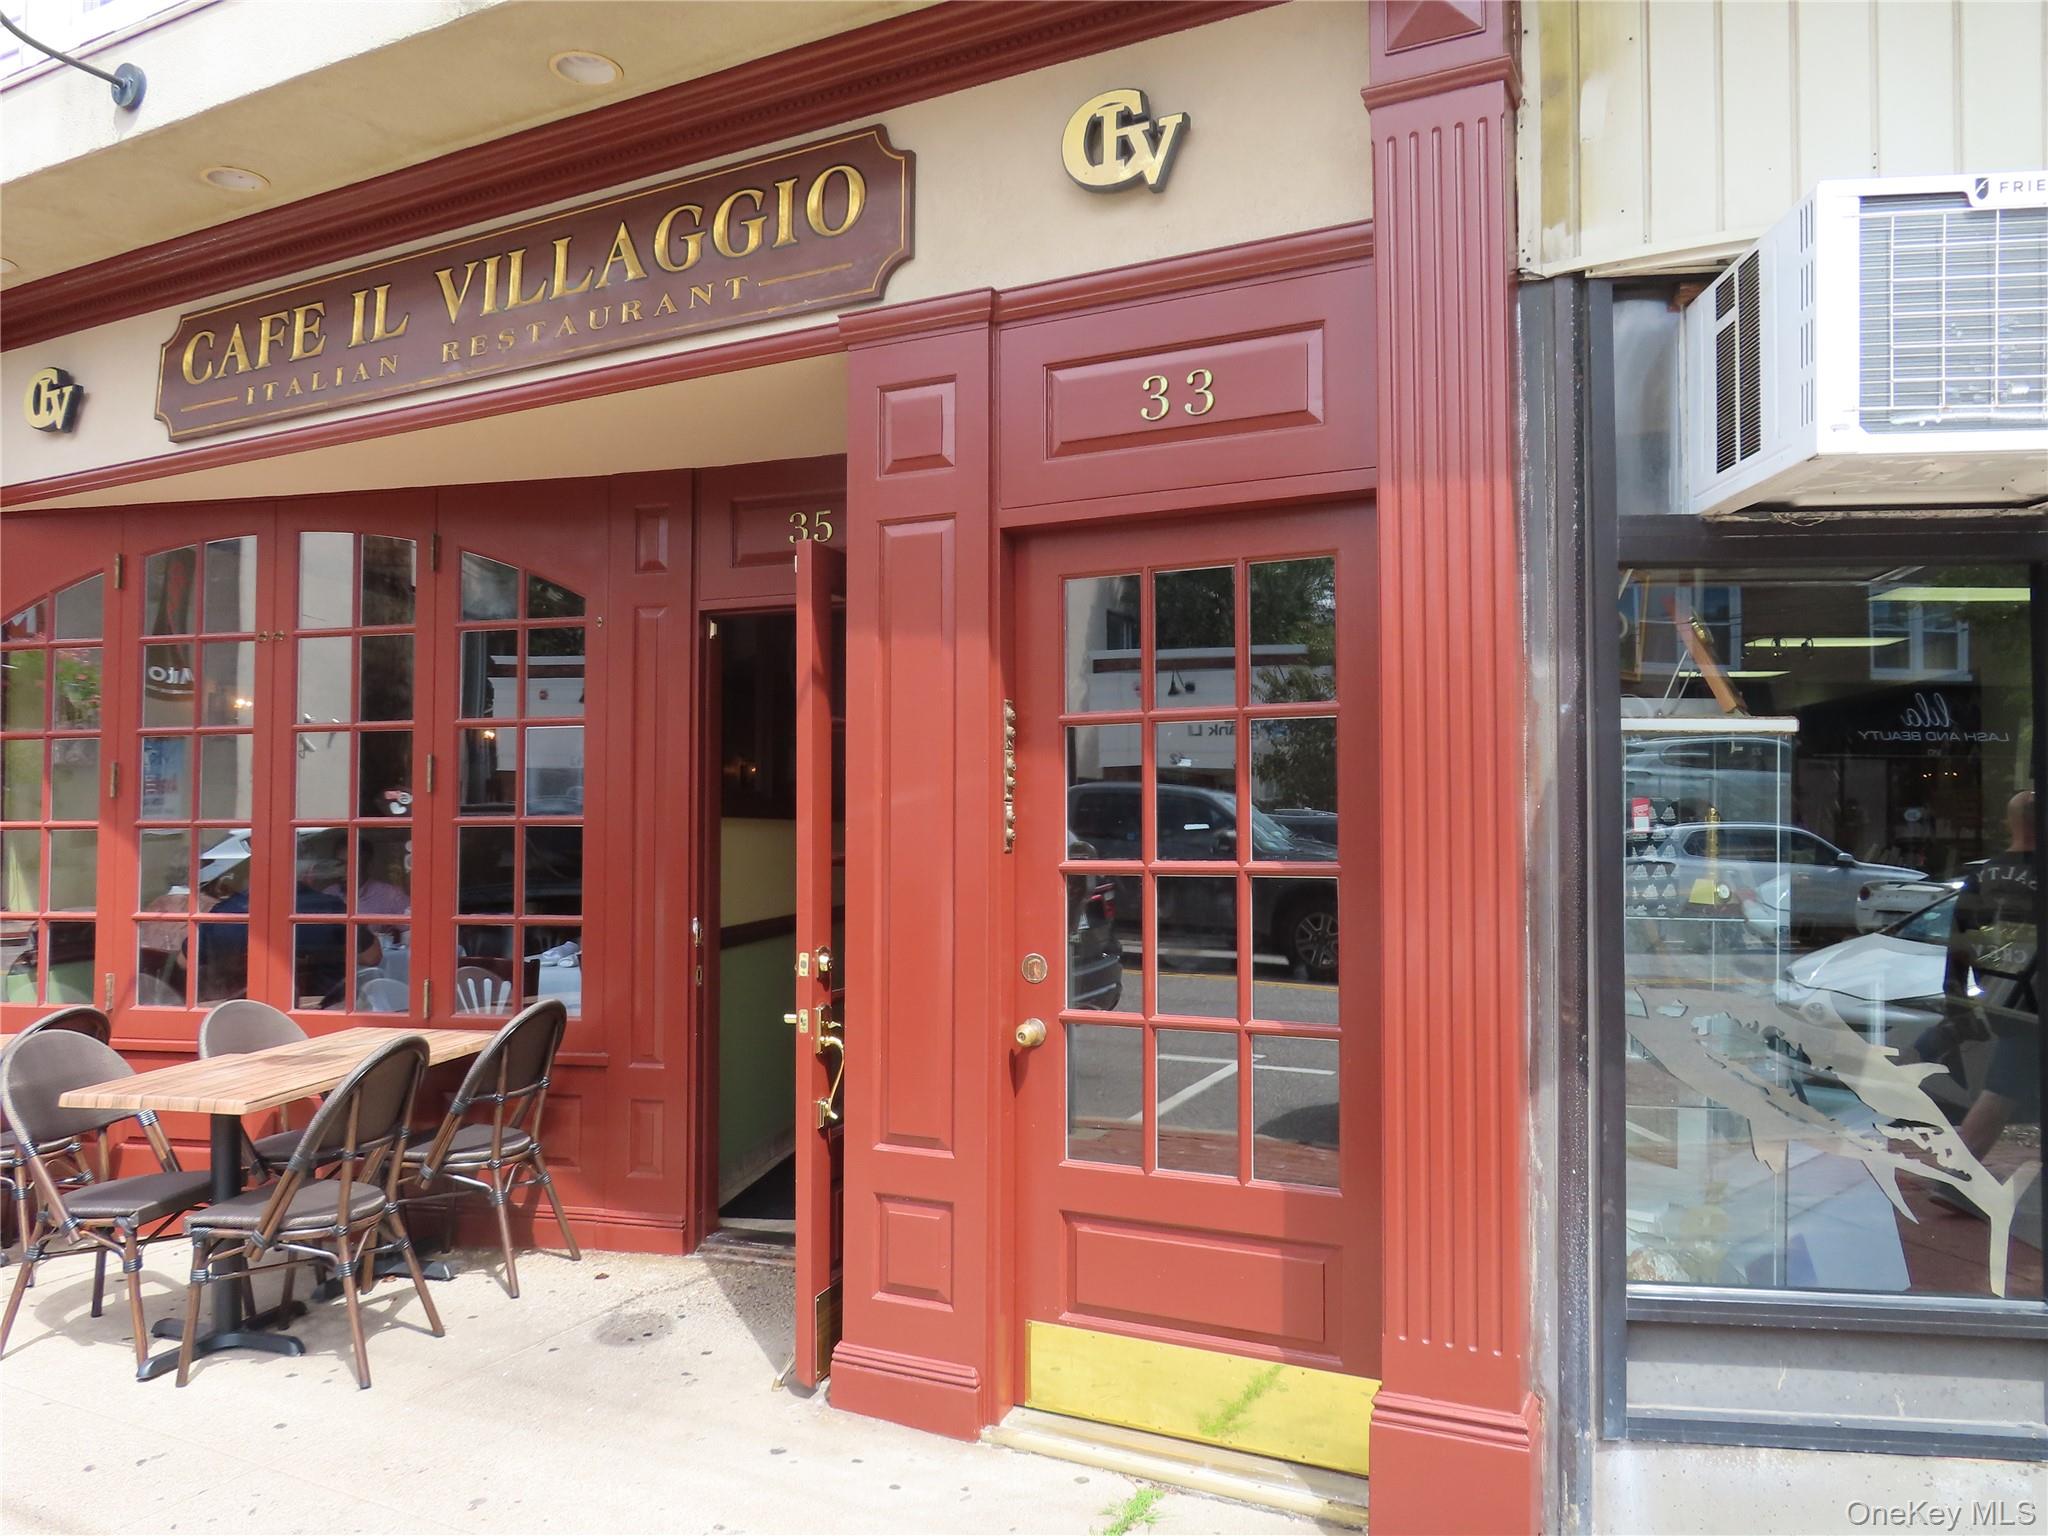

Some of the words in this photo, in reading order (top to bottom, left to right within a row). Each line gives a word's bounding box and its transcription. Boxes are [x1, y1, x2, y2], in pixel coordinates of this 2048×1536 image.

[2000, 179, 2047, 194] FRIE
[182, 301, 327, 385] CAFE
[348, 283, 409, 349] IL
[434, 164, 867, 325] VILLAGGIO
[246, 354, 399, 406] ITALIAN
[440, 275, 750, 364] RESTAURANT
[1140, 368, 1215, 422] 33
[788, 510, 833, 544] 35
